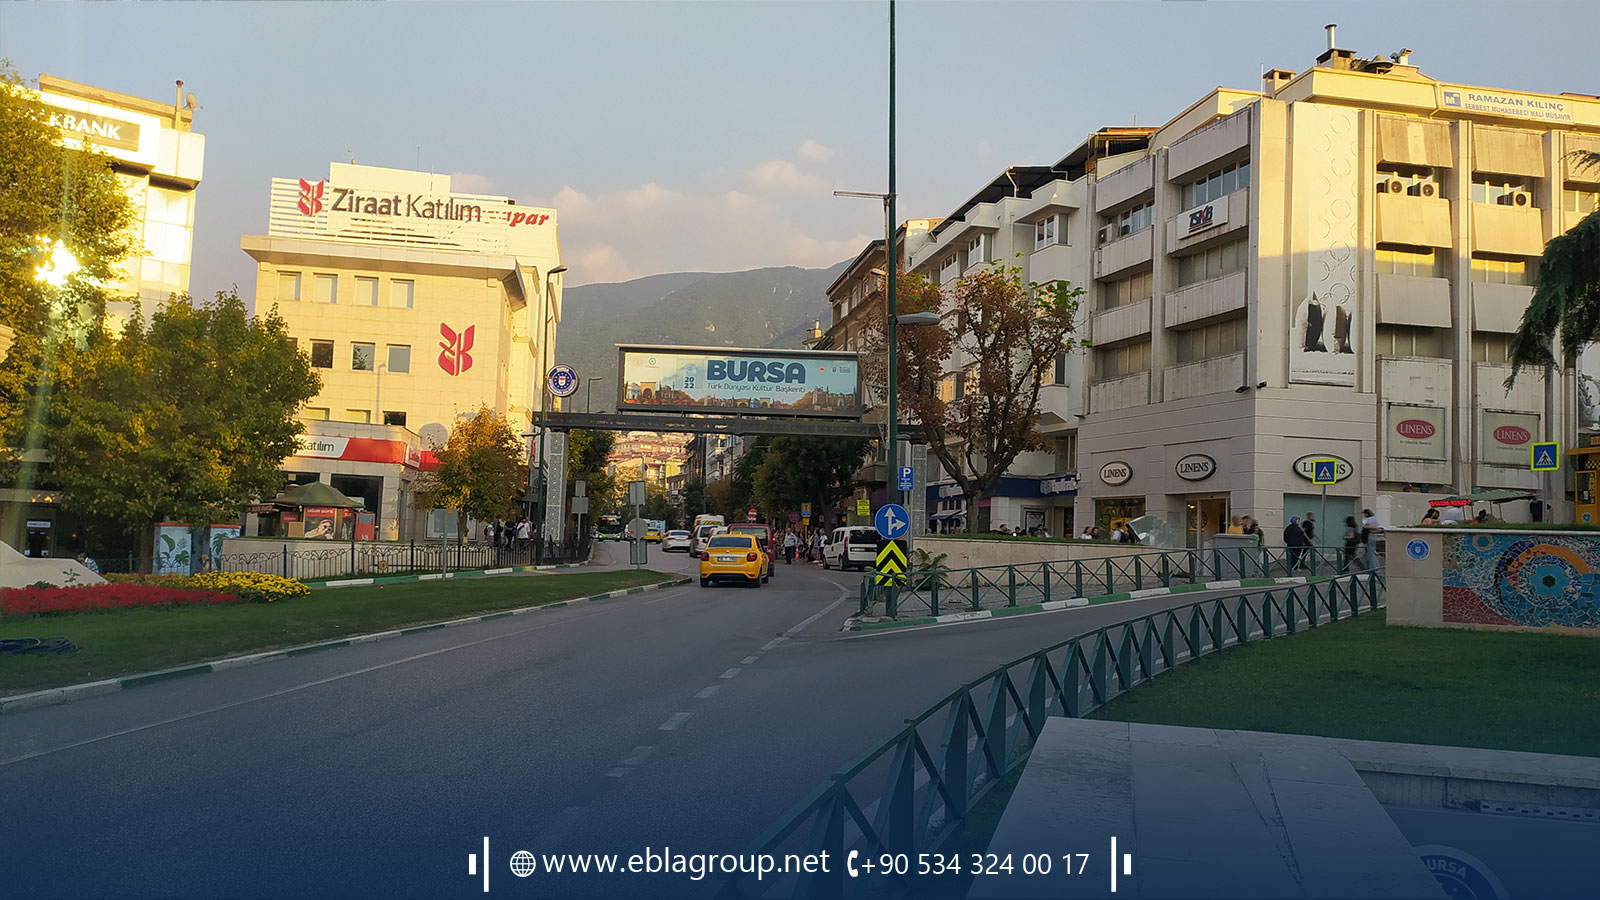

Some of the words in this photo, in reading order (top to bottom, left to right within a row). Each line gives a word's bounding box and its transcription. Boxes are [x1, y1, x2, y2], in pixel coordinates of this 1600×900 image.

[1464, 103, 1490, 112] SERBEST
[1468, 93, 1523, 106] RAMAZAN
[1527, 100, 1565, 111] KILINÇ
[49, 111, 121, 141] KBANK
[331, 188, 402, 216] Ziraat
[407, 194, 481, 222] Katılım
[1189, 205, 1214, 227] TSKB
[707, 359, 806, 384] BURSA
[707, 382, 722, 390] Türk
[1400, 424, 1433, 435] LINENS
[1496, 430, 1529, 441] LINENS
[903, 468, 911, 477] P
[1103, 468, 1127, 478] LINENS
[1180, 462, 1209, 473] LINENS
[1426, 858, 1467, 878] URSA
